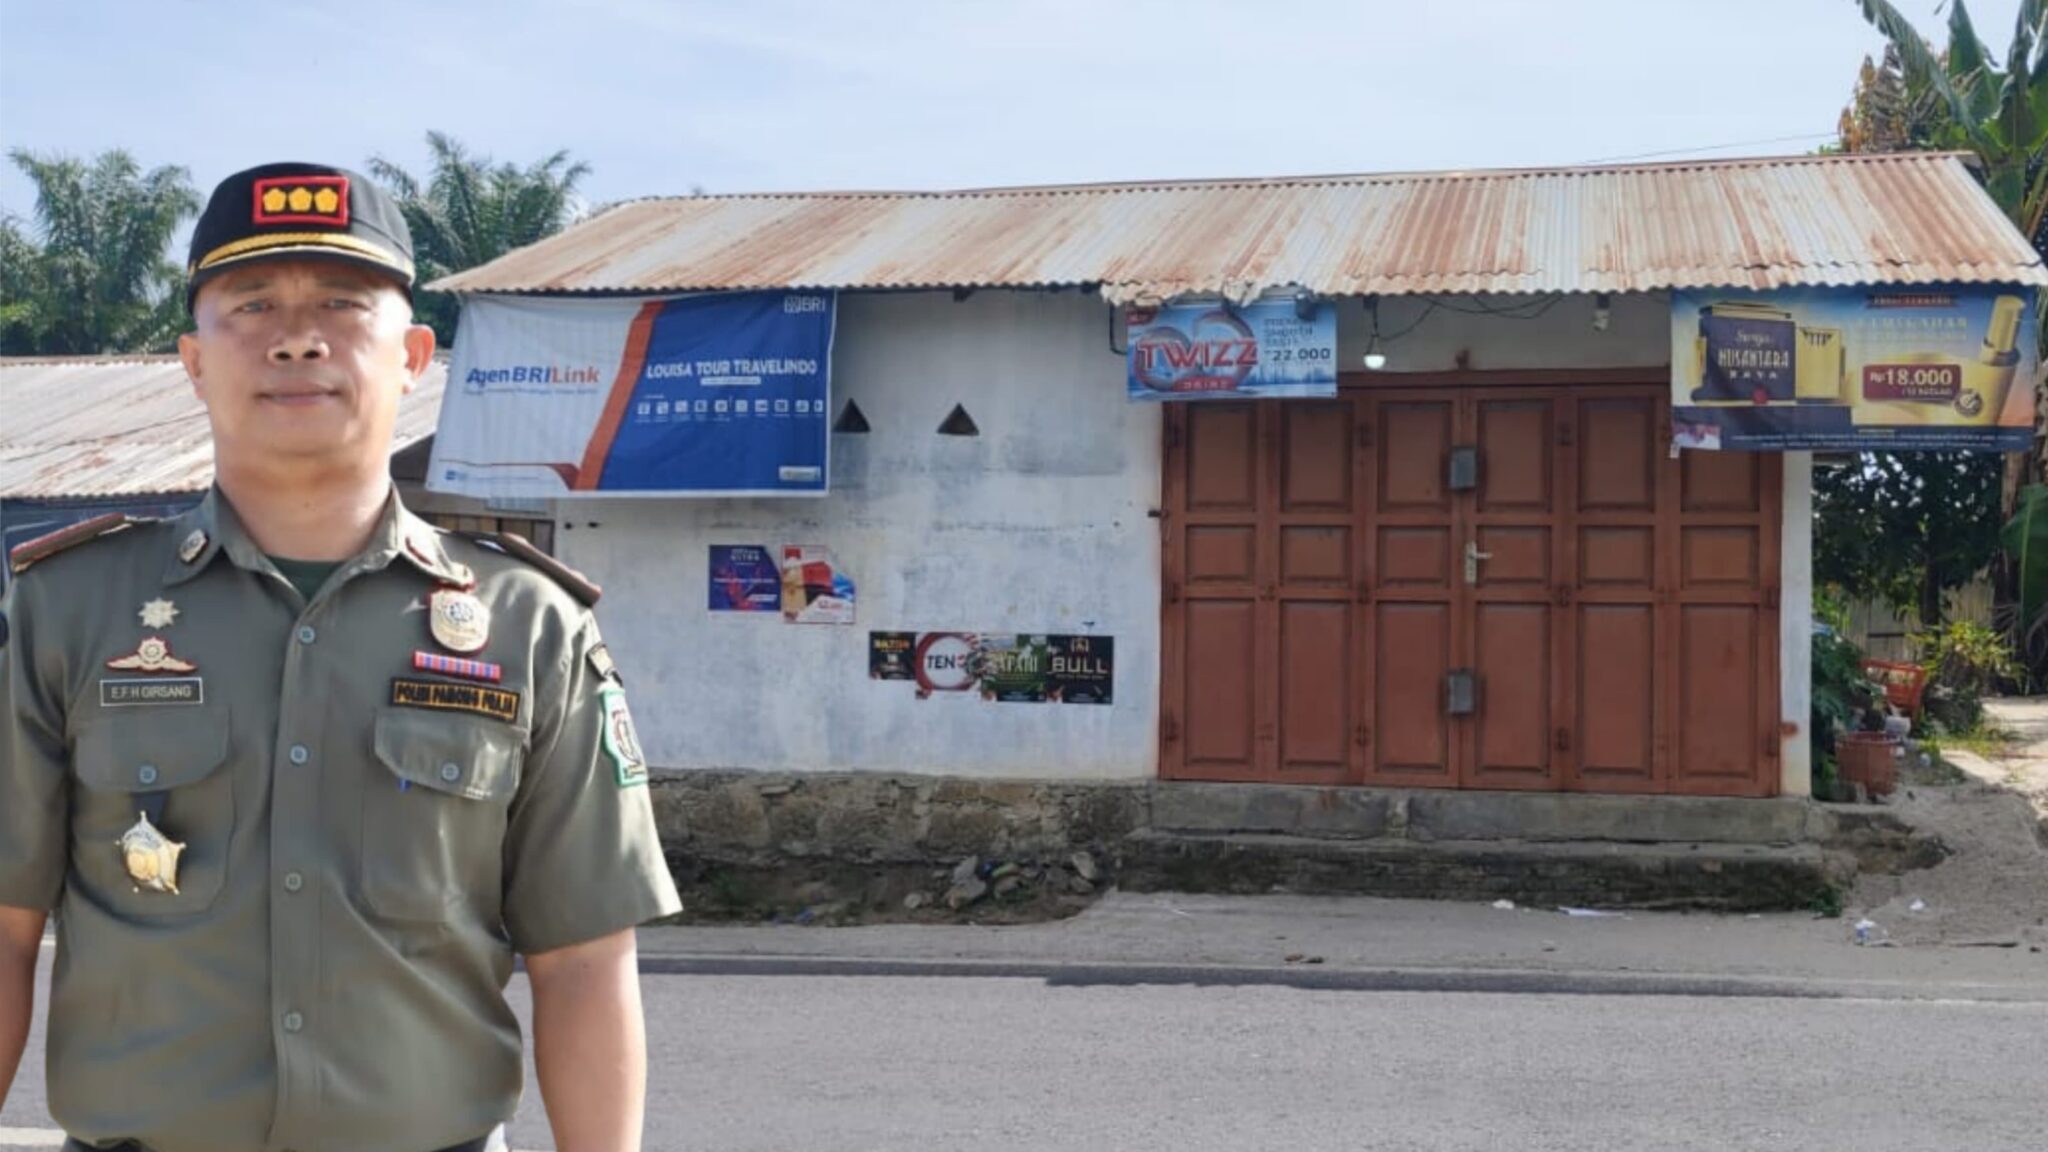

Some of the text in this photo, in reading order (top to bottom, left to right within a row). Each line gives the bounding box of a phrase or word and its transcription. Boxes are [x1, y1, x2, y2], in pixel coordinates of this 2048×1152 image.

[1136, 337, 1258, 370] TWIZZ
[647, 357, 817, 379] LOUISA TOUR TRAVELINDO
[1051, 656, 1109, 674] BULL
